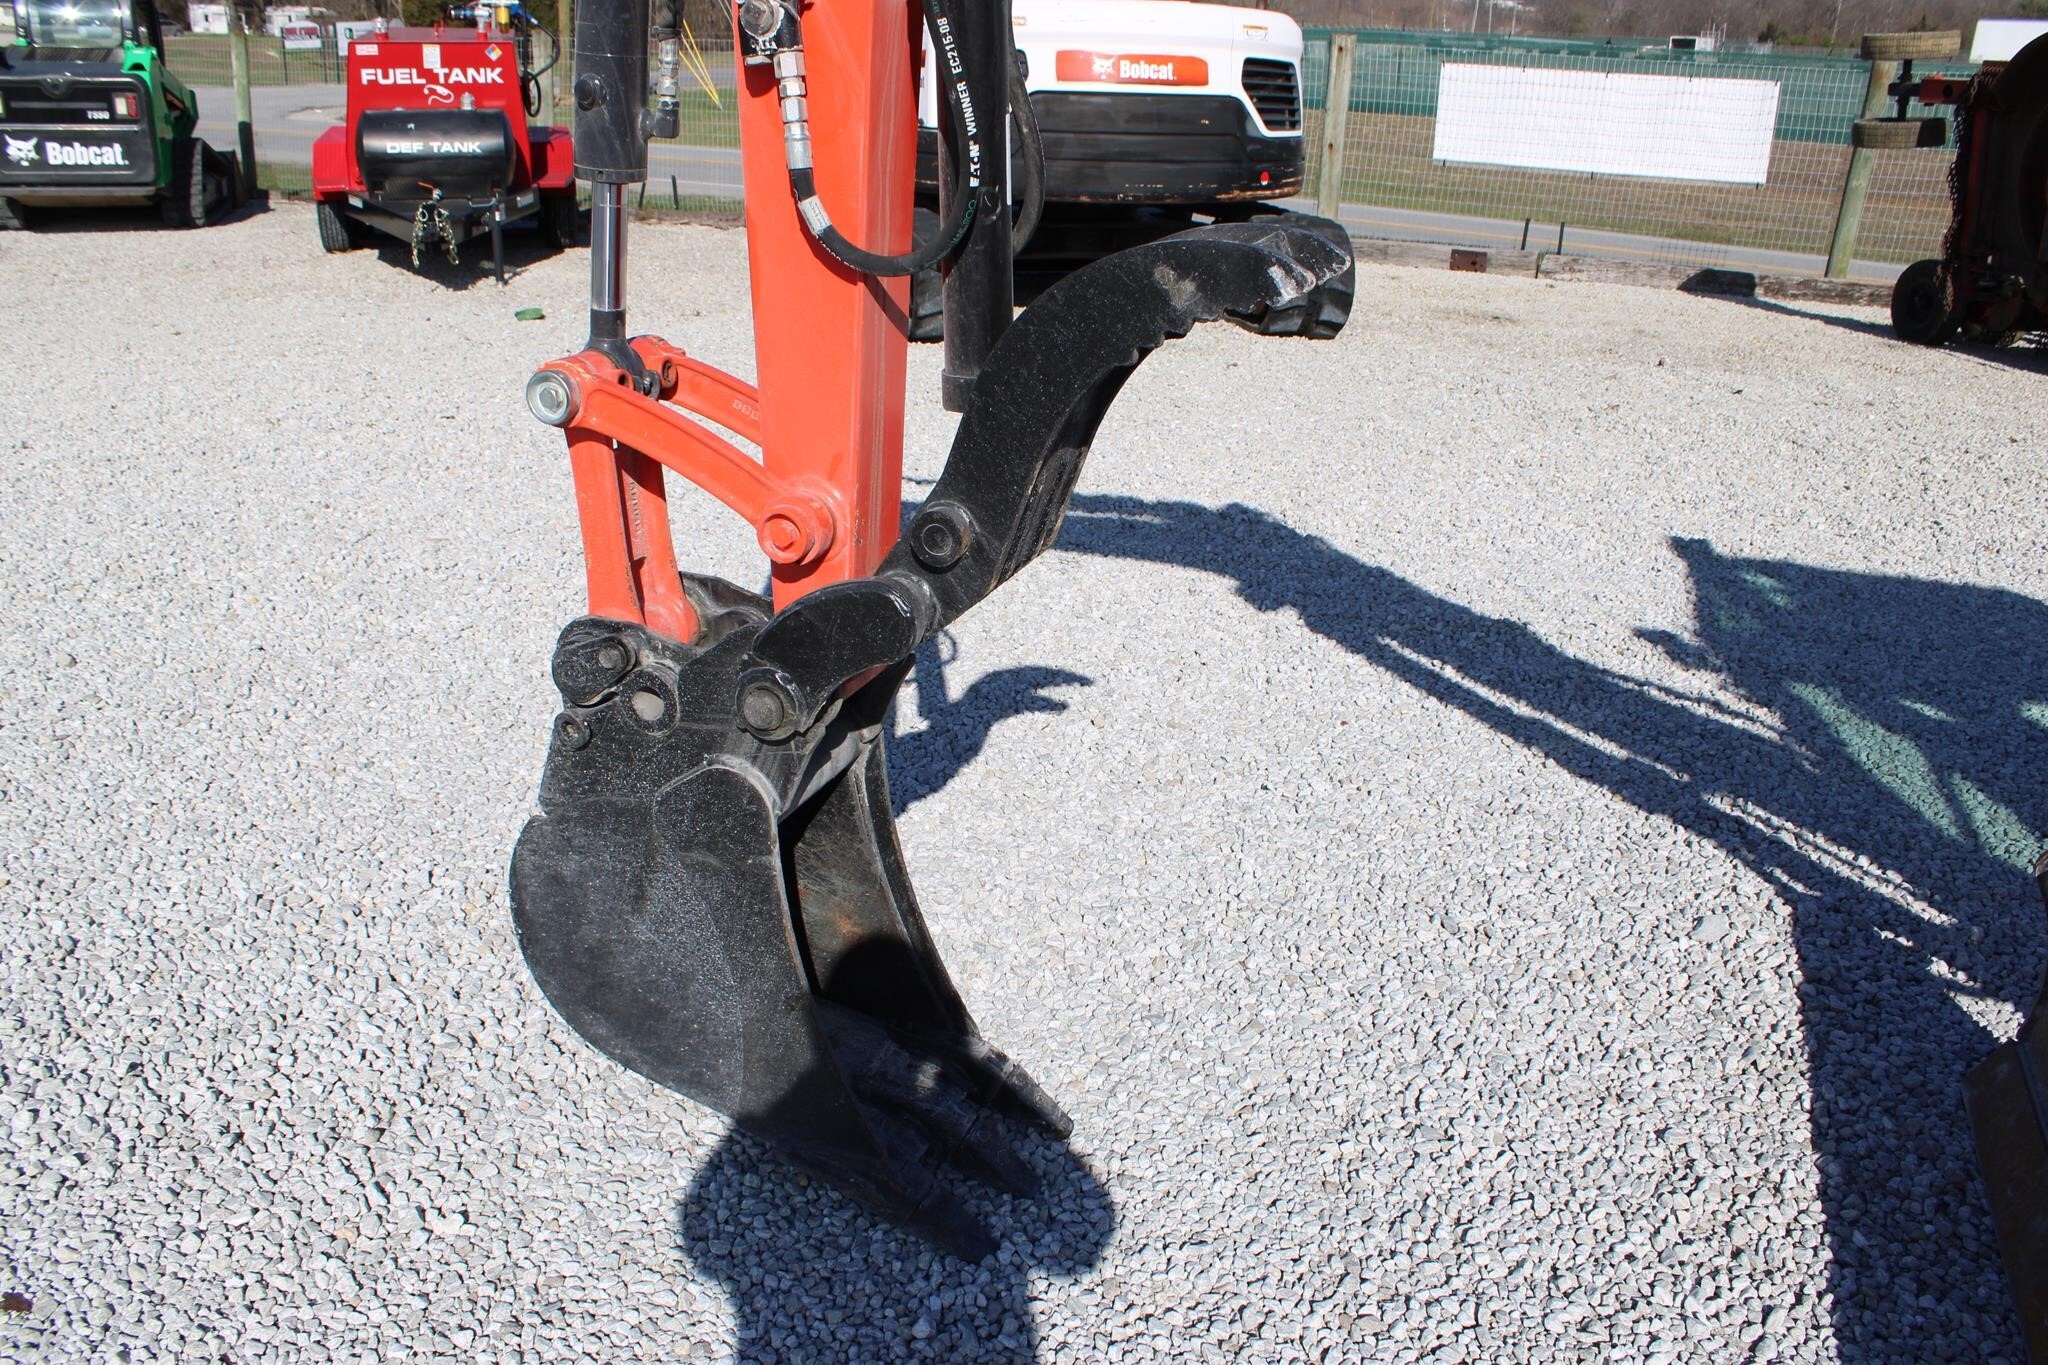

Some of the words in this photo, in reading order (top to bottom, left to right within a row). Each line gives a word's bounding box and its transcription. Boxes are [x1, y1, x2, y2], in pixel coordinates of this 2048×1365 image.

[936, 17, 963, 75] EC215-08
[360, 68, 426, 85] FUEL
[433, 67, 504, 84] TANK
[1120, 60, 1174, 81] Bobcat
[956, 80, 977, 136] WINNER
[44, 141, 125, 166] Bobcat
[386, 143, 424, 154] DEF
[429, 141, 482, 153] TANK
